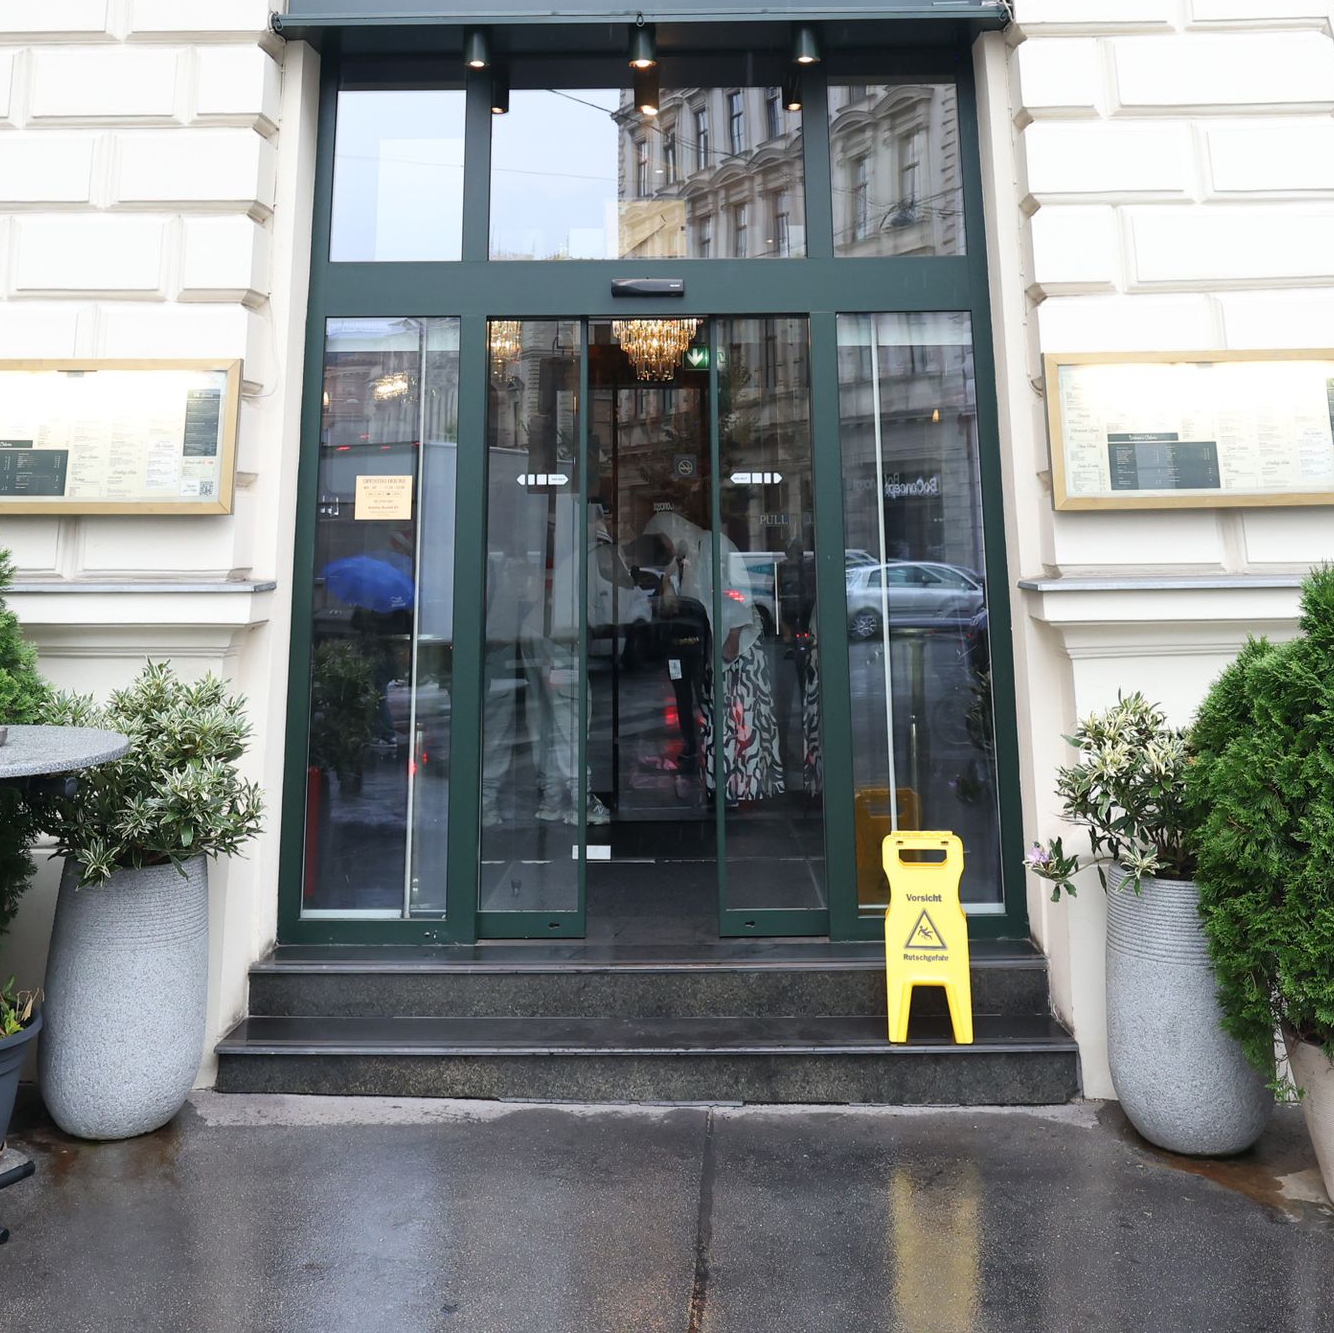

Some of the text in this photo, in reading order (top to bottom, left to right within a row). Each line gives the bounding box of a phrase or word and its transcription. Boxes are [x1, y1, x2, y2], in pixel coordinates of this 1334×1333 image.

[759, 514, 789, 525] PULL
[906, 893, 942, 903] Vorsicht
[903, 953, 949, 963] Rutschgefahr
